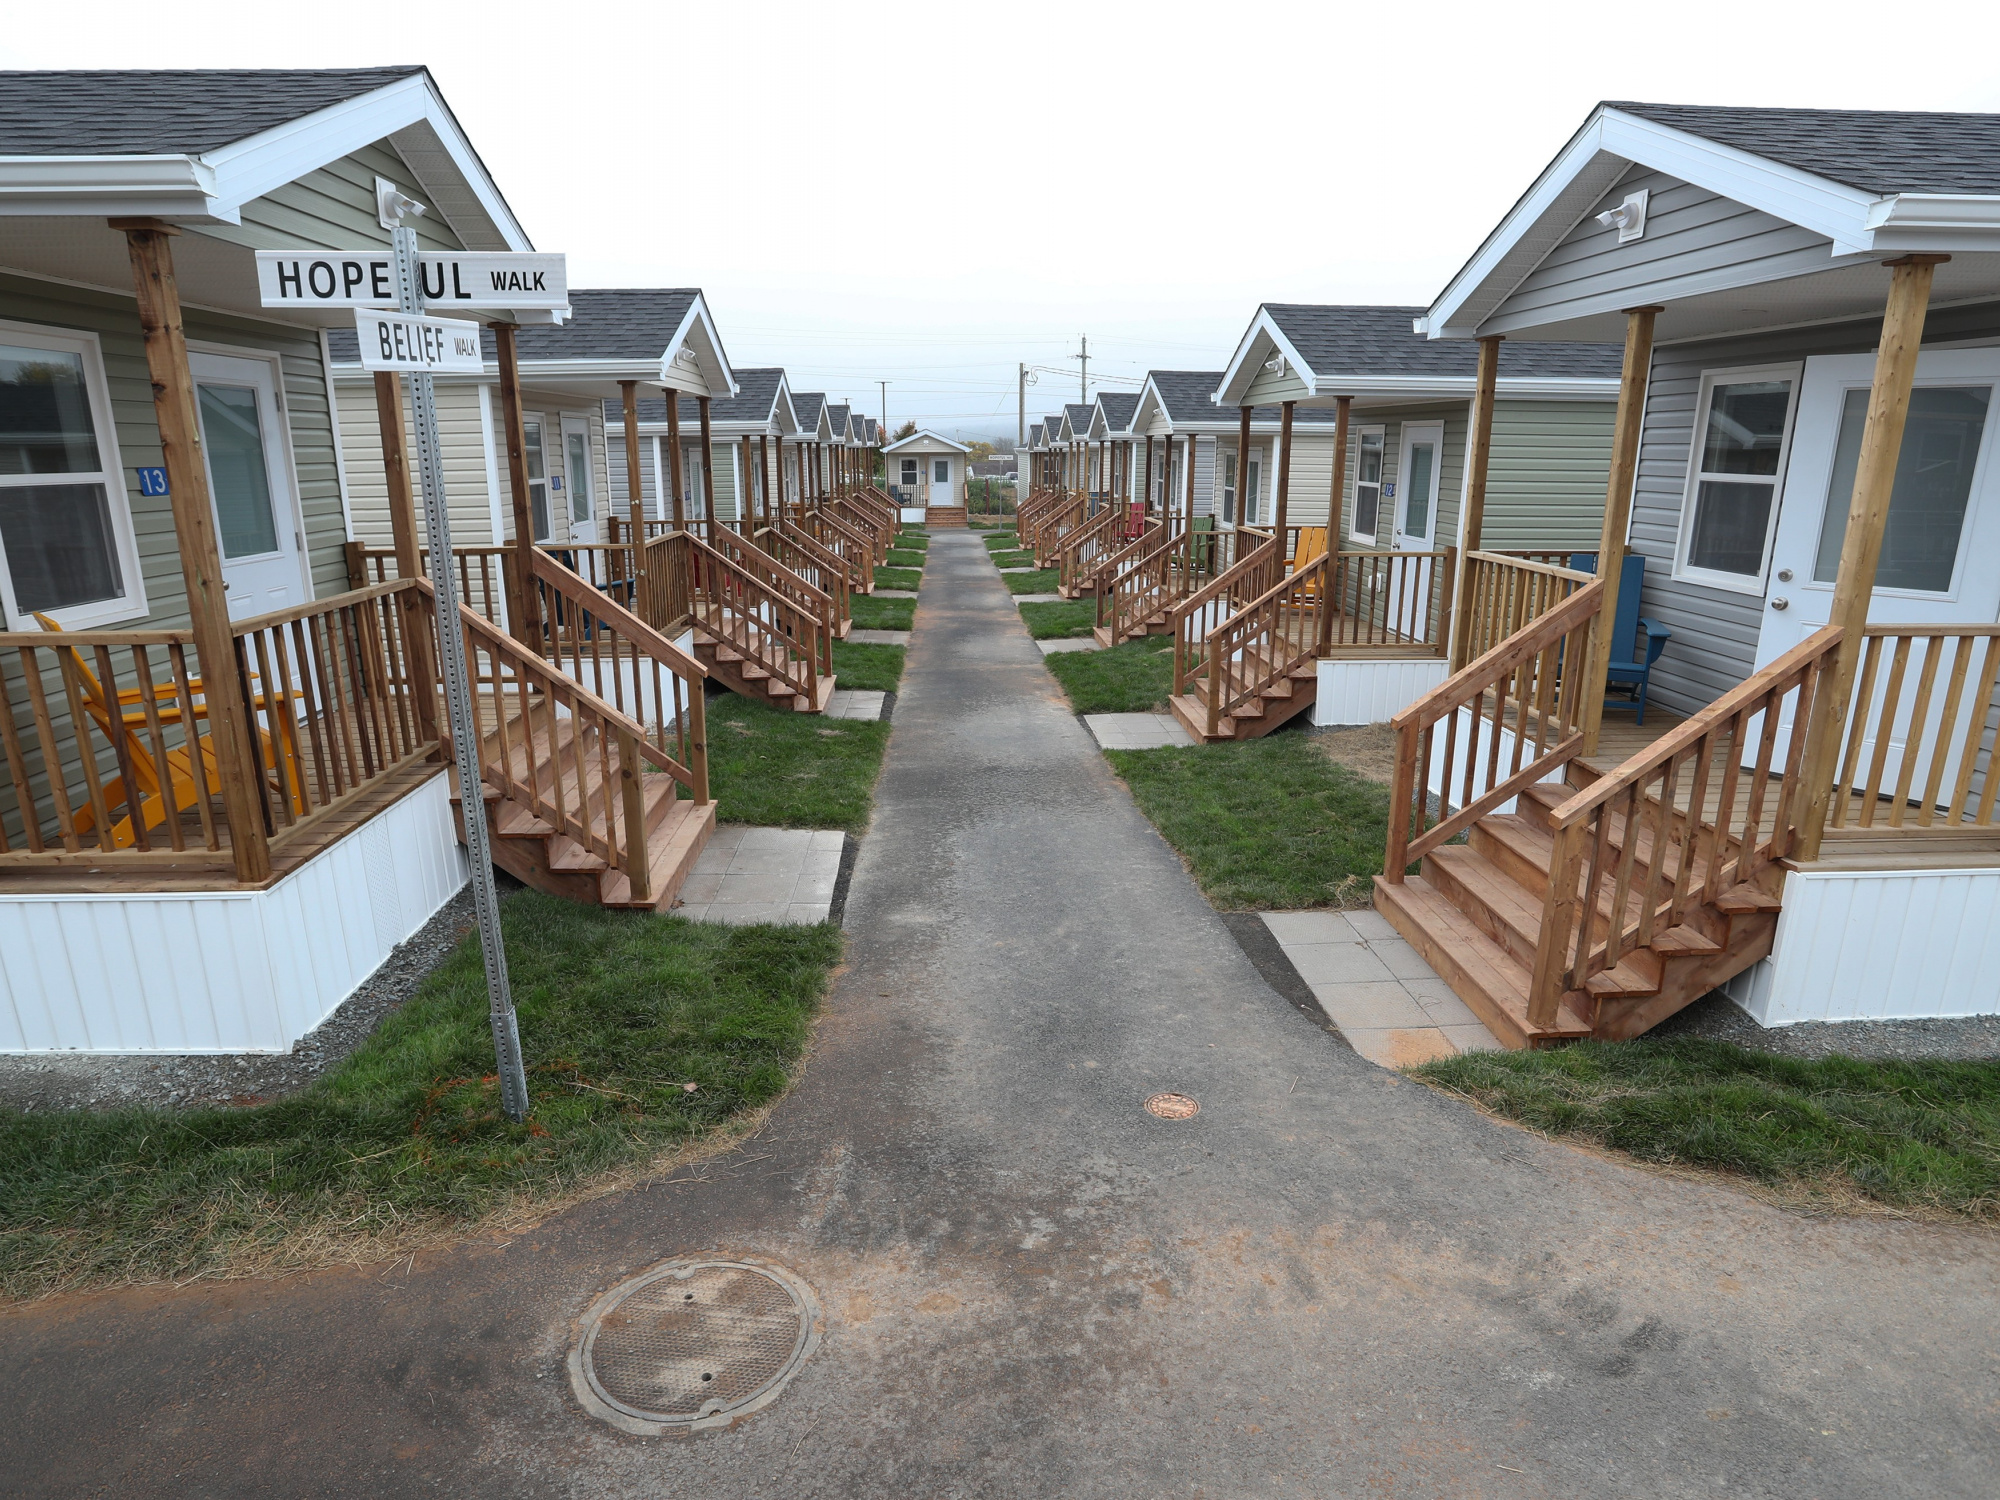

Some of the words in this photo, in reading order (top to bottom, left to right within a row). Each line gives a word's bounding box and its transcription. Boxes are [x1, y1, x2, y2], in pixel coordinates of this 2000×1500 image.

[277, 261, 471, 299] HOPEUL
[491, 271, 546, 291] WALK
[378, 321, 443, 362] BELIEF
[454, 337, 477, 356] WALK
[143, 469, 166, 493] 13
[1385, 484, 1393, 495] 12
